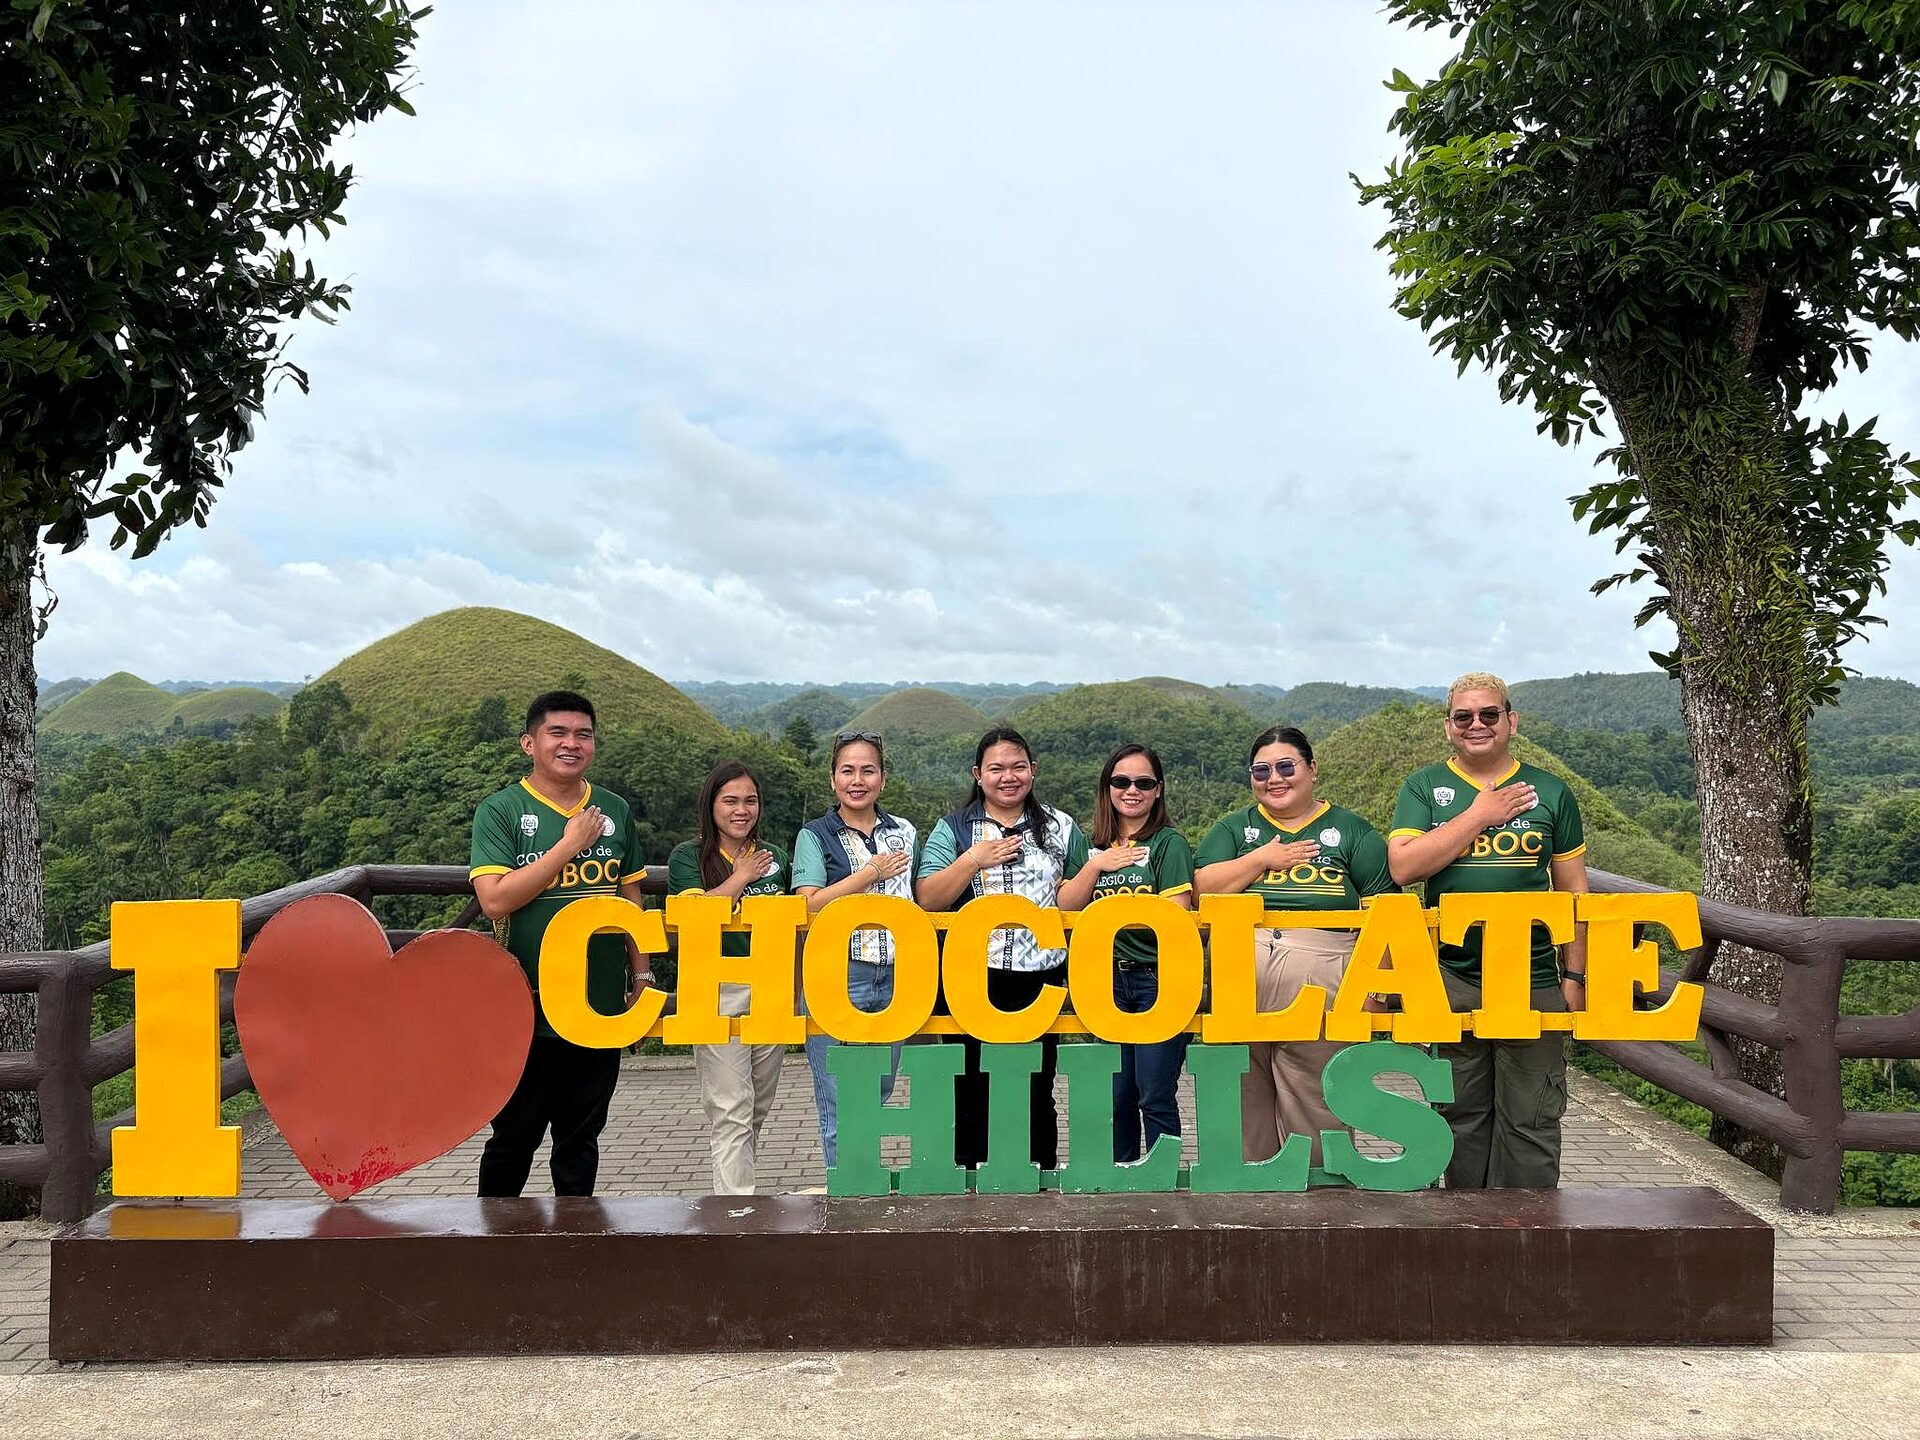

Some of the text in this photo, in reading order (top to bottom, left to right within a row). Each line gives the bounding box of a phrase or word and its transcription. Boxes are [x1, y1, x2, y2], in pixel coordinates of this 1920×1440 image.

[596, 845, 613, 857] de
[1459, 831, 1543, 858] BOC
[763, 883, 779, 893] de
[1128, 873, 1143, 884] de
[111, 891, 1704, 1197] I CHOCOLATE
[827, 1041, 1455, 1197] HILLS
